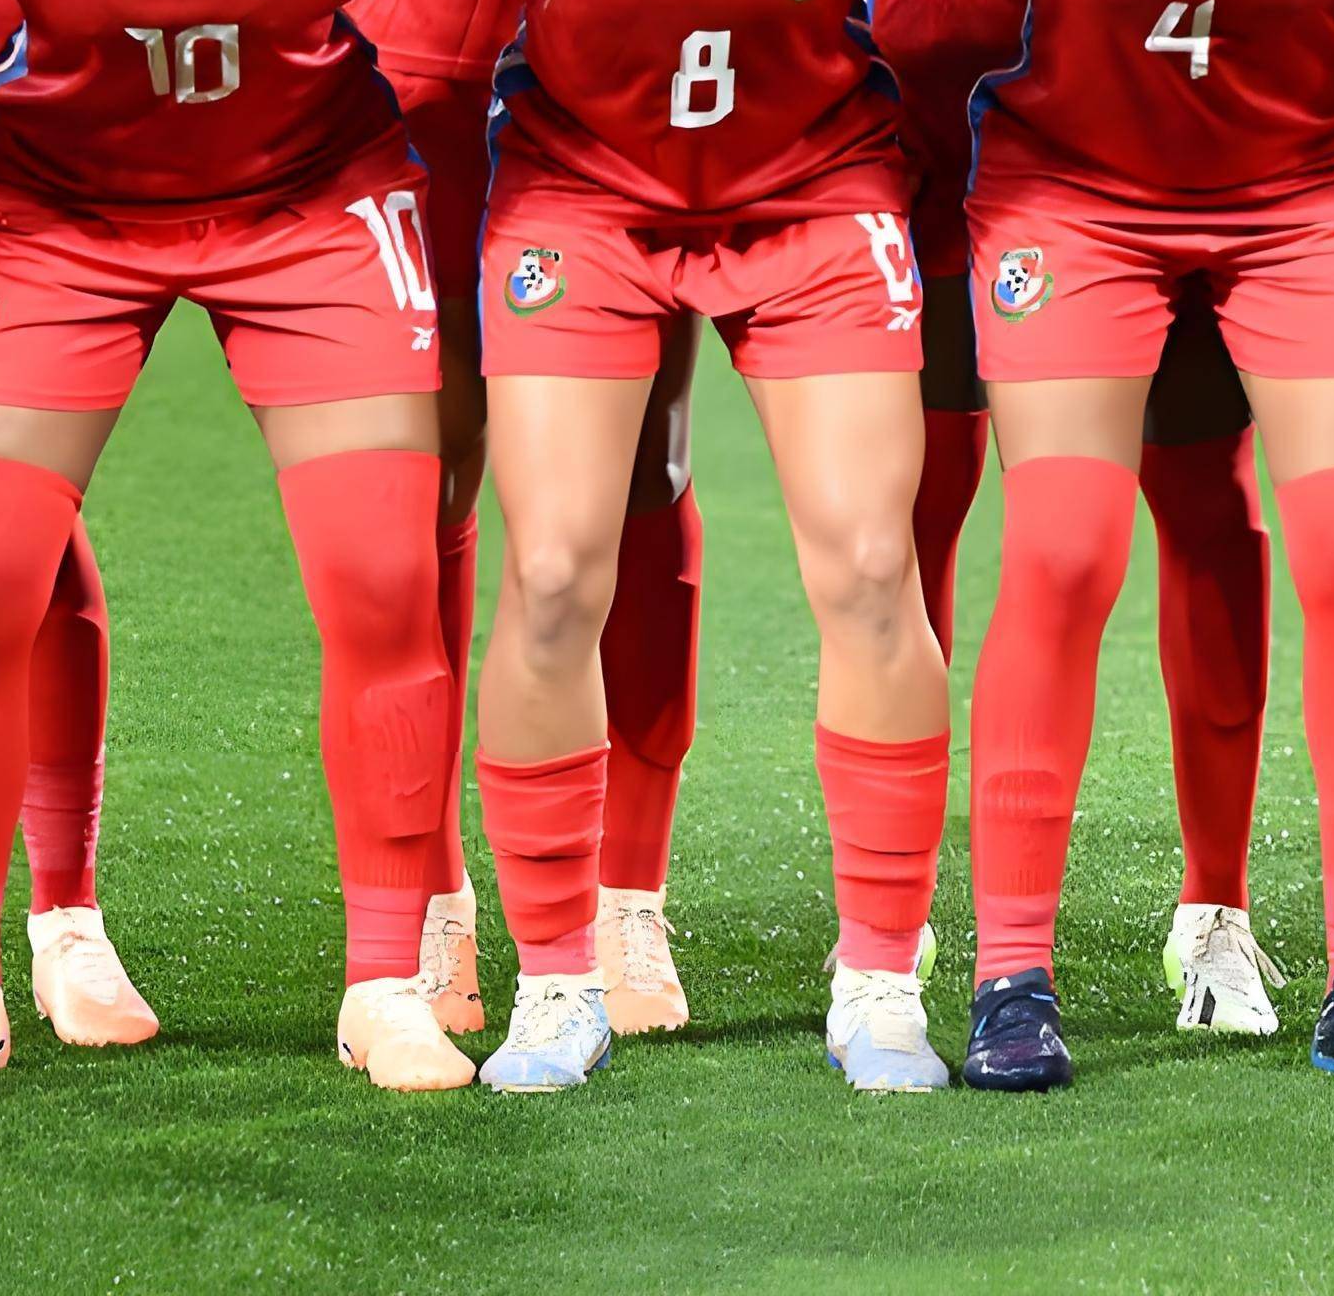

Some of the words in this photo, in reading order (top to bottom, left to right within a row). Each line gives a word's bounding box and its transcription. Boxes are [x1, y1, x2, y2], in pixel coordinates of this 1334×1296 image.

[124, 23, 240, 103] 10
[670, 30, 735, 129] 8
[1145, 0, 1215, 79] 4
[345, 191, 437, 311] 10
